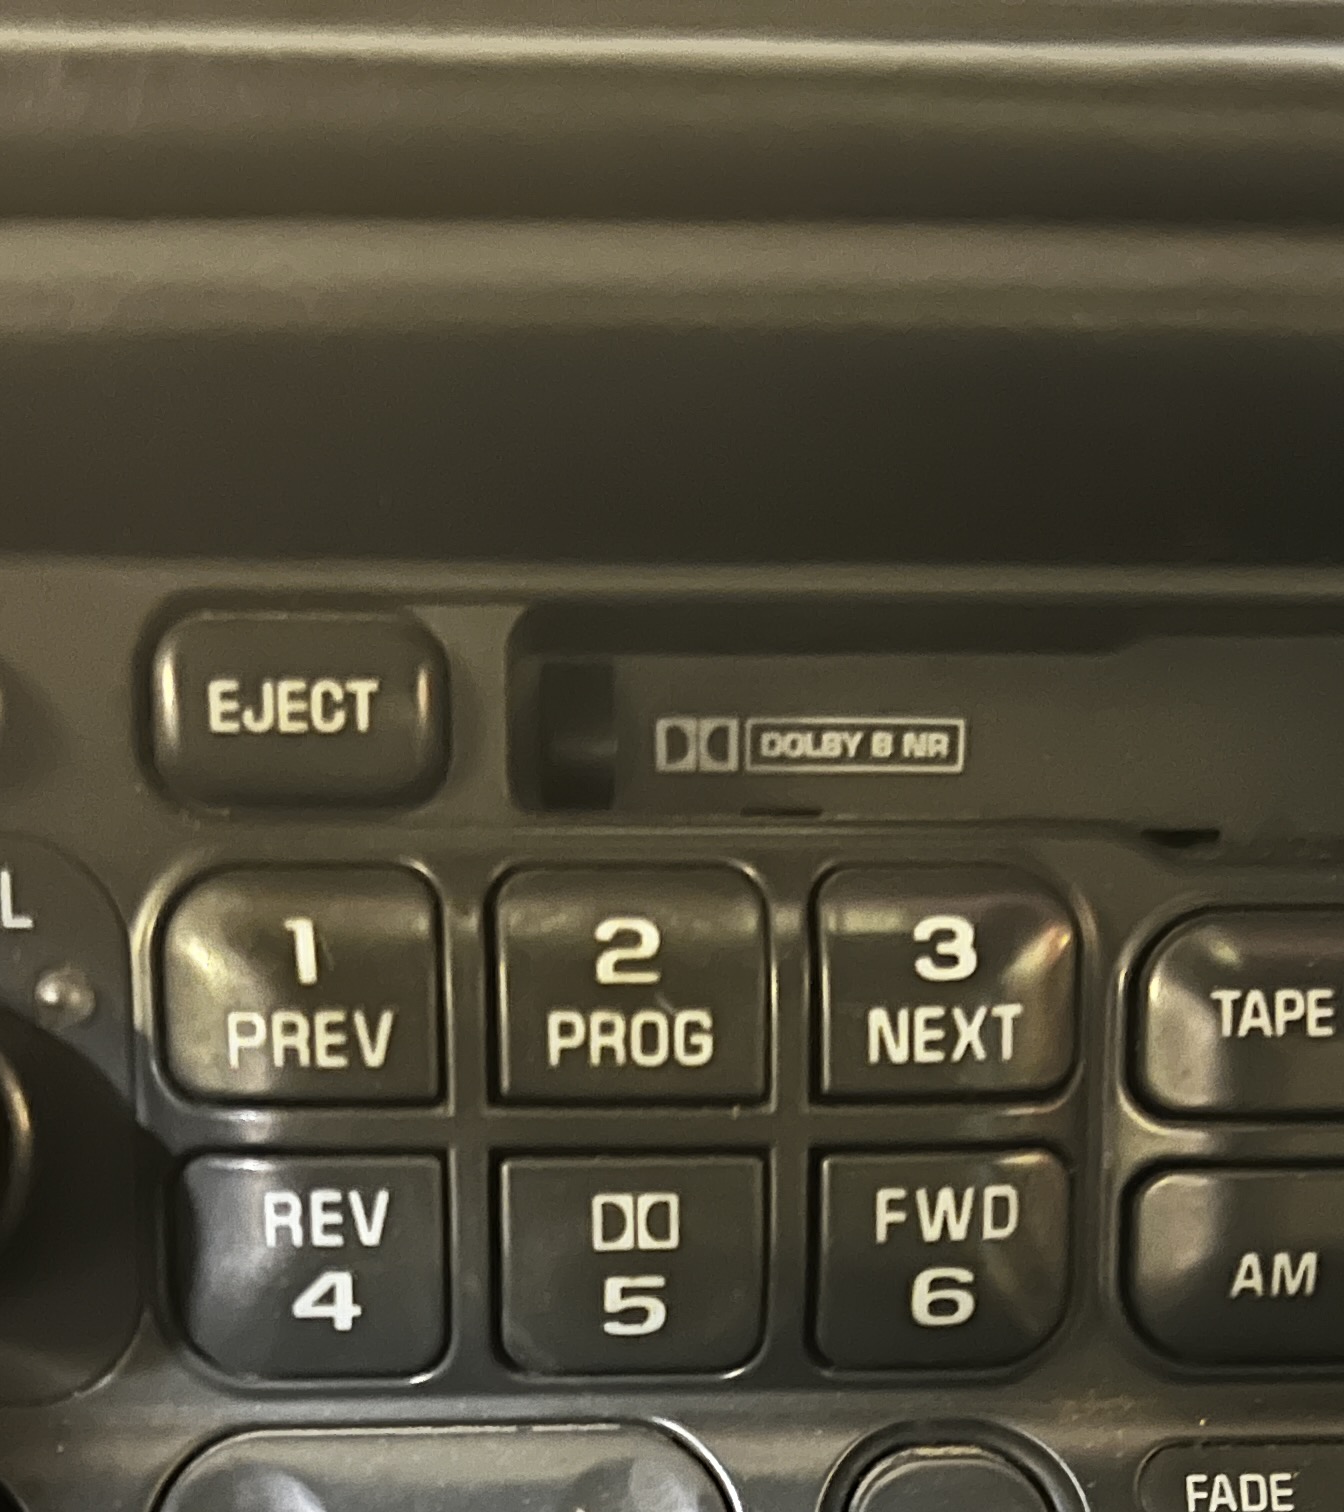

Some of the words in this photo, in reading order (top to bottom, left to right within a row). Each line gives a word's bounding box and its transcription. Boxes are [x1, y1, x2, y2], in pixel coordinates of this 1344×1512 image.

[207, 680, 379, 735] EJECT
[760, 730, 862, 759] DOLBY
[871, 731, 891, 758] B
[902, 730, 950, 759] NR
[285, 918, 319, 985] 1
[594, 917, 661, 985] 2
[912, 915, 978, 982] 3
[226, 1010, 395, 1069] PREV
[546, 1010, 715, 1068] PROG
[867, 1003, 1023, 1065] NEXT
[1212, 988, 1335, 1039] TAPE
[264, 1190, 390, 1248] REV
[875, 1184, 1021, 1244] FWD
[292, 1271, 362, 1332] 4
[602, 1275, 669, 1336] 5
[910, 1267, 977, 1327] 6
[1231, 1252, 1318, 1299] AM
